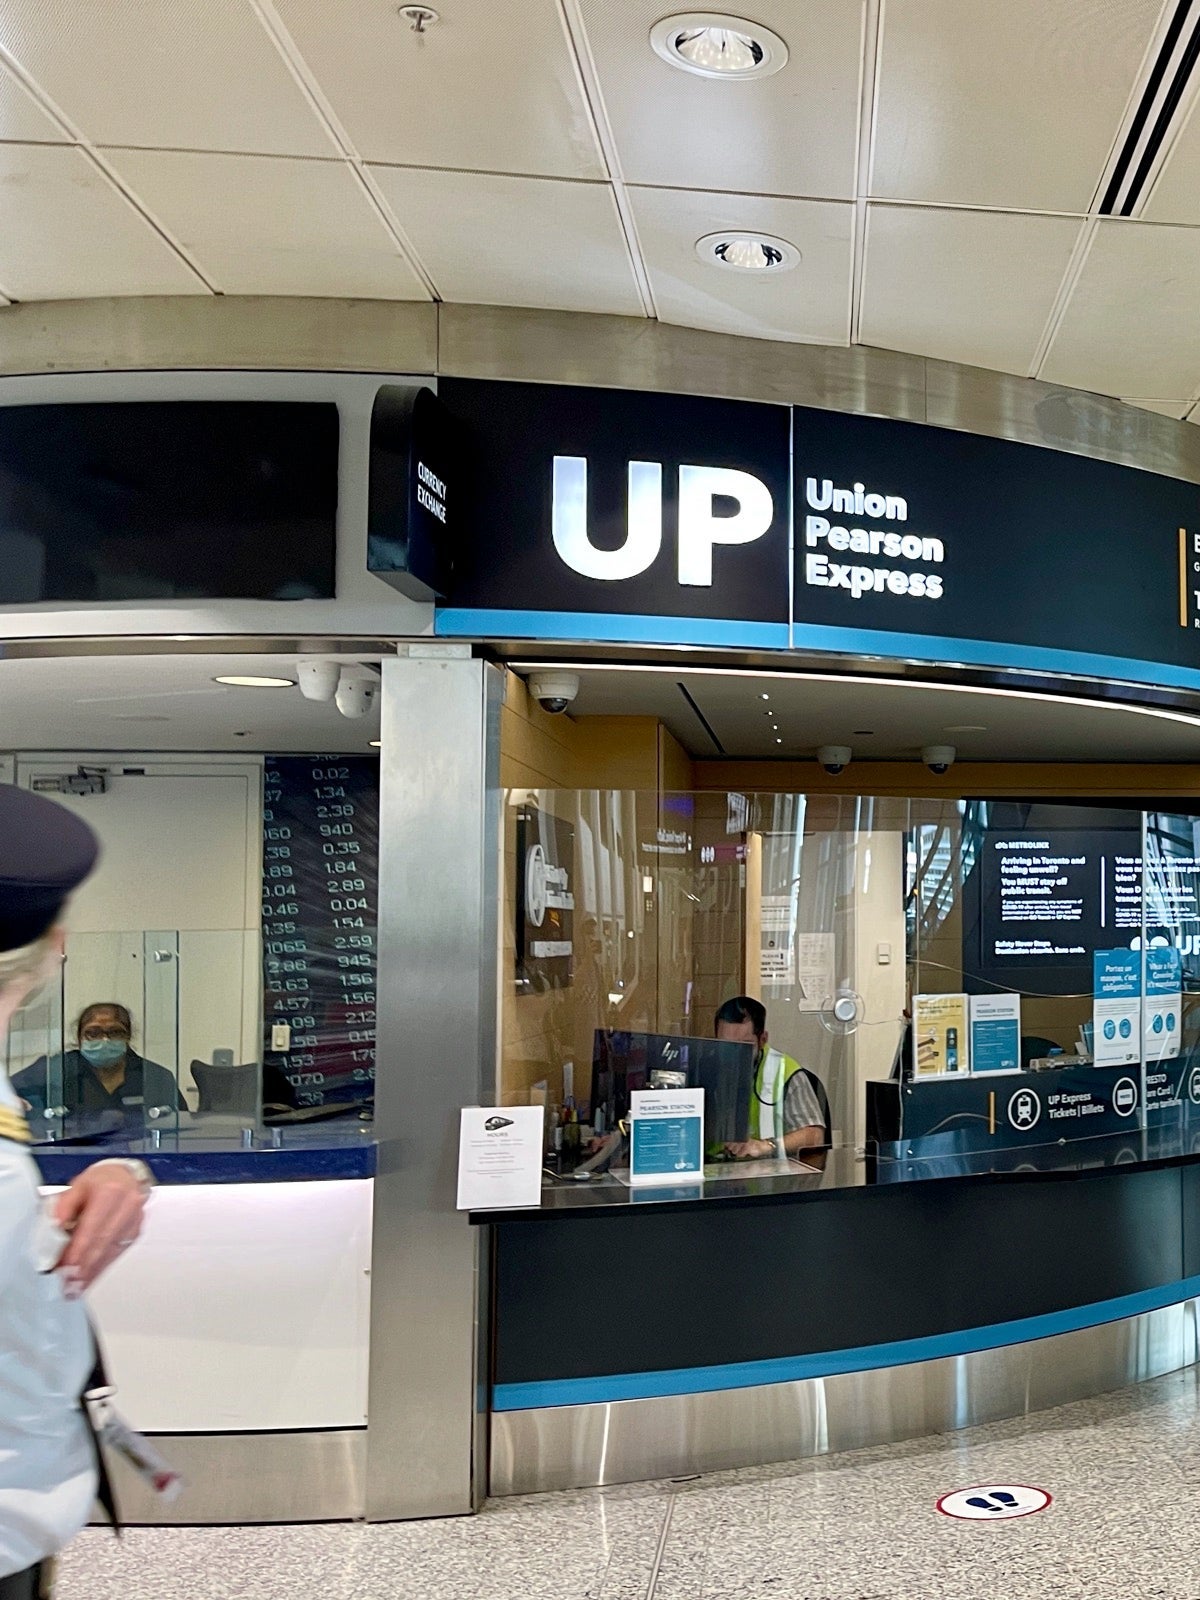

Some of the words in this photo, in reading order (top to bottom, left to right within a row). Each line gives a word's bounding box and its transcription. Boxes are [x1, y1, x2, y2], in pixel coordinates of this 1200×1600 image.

[417, 461, 447, 501] CURRENCY
[417, 484, 447, 524] EXCHANGE
[806, 477, 908, 521] Union
[552, 455, 774, 587] UP
[806, 515, 945, 563] Pearson
[806, 553, 945, 599] Express
[312, 767, 350, 780] 0.02
[314, 786, 346, 799] 1.34
[316, 804, 354, 818] 2.38
[319, 823, 354, 837] 940
[322, 841, 360, 856] 0.35
[325, 860, 357, 874] 1.84
[1001, 857, 1032, 866] Arriving
[1032, 857, 1040, 865] in
[1040, 856, 1070, 865] Toronto
[1070, 856, 1086, 865] and
[1001, 865, 1028, 875] feeling
[1028, 865, 1059, 874] unwell?
[327, 878, 366, 893] 2.89
[1001, 877, 1016, 886] You
[1016, 877, 1040, 886] MUST
[1040, 878, 1056, 887] stay
[1001, 886, 1025, 897] public
[262, 902, 299, 917] 0.46
[330, 897, 368, 911] 0.04
[263, 921, 296, 936] 1.35
[265, 940, 307, 954] 1065
[334, 935, 373, 949] 2.59
[337, 953, 371, 968] 945
[340, 972, 373, 986] 1.56
[273, 996, 310, 1011] 4.57
[341, 991, 376, 1005] 1.56
[661, 1041, 679, 1064] hp
[285, 1072, 325, 1087] 070
[1146, 1073, 1167, 1084] RESTO
[1048, 1094, 1060, 1105] UP
[1061, 1093, 1091, 1105] Express
[1048, 1108, 1077, 1119] Tickets
[1081, 1104, 1105, 1115] Billets
